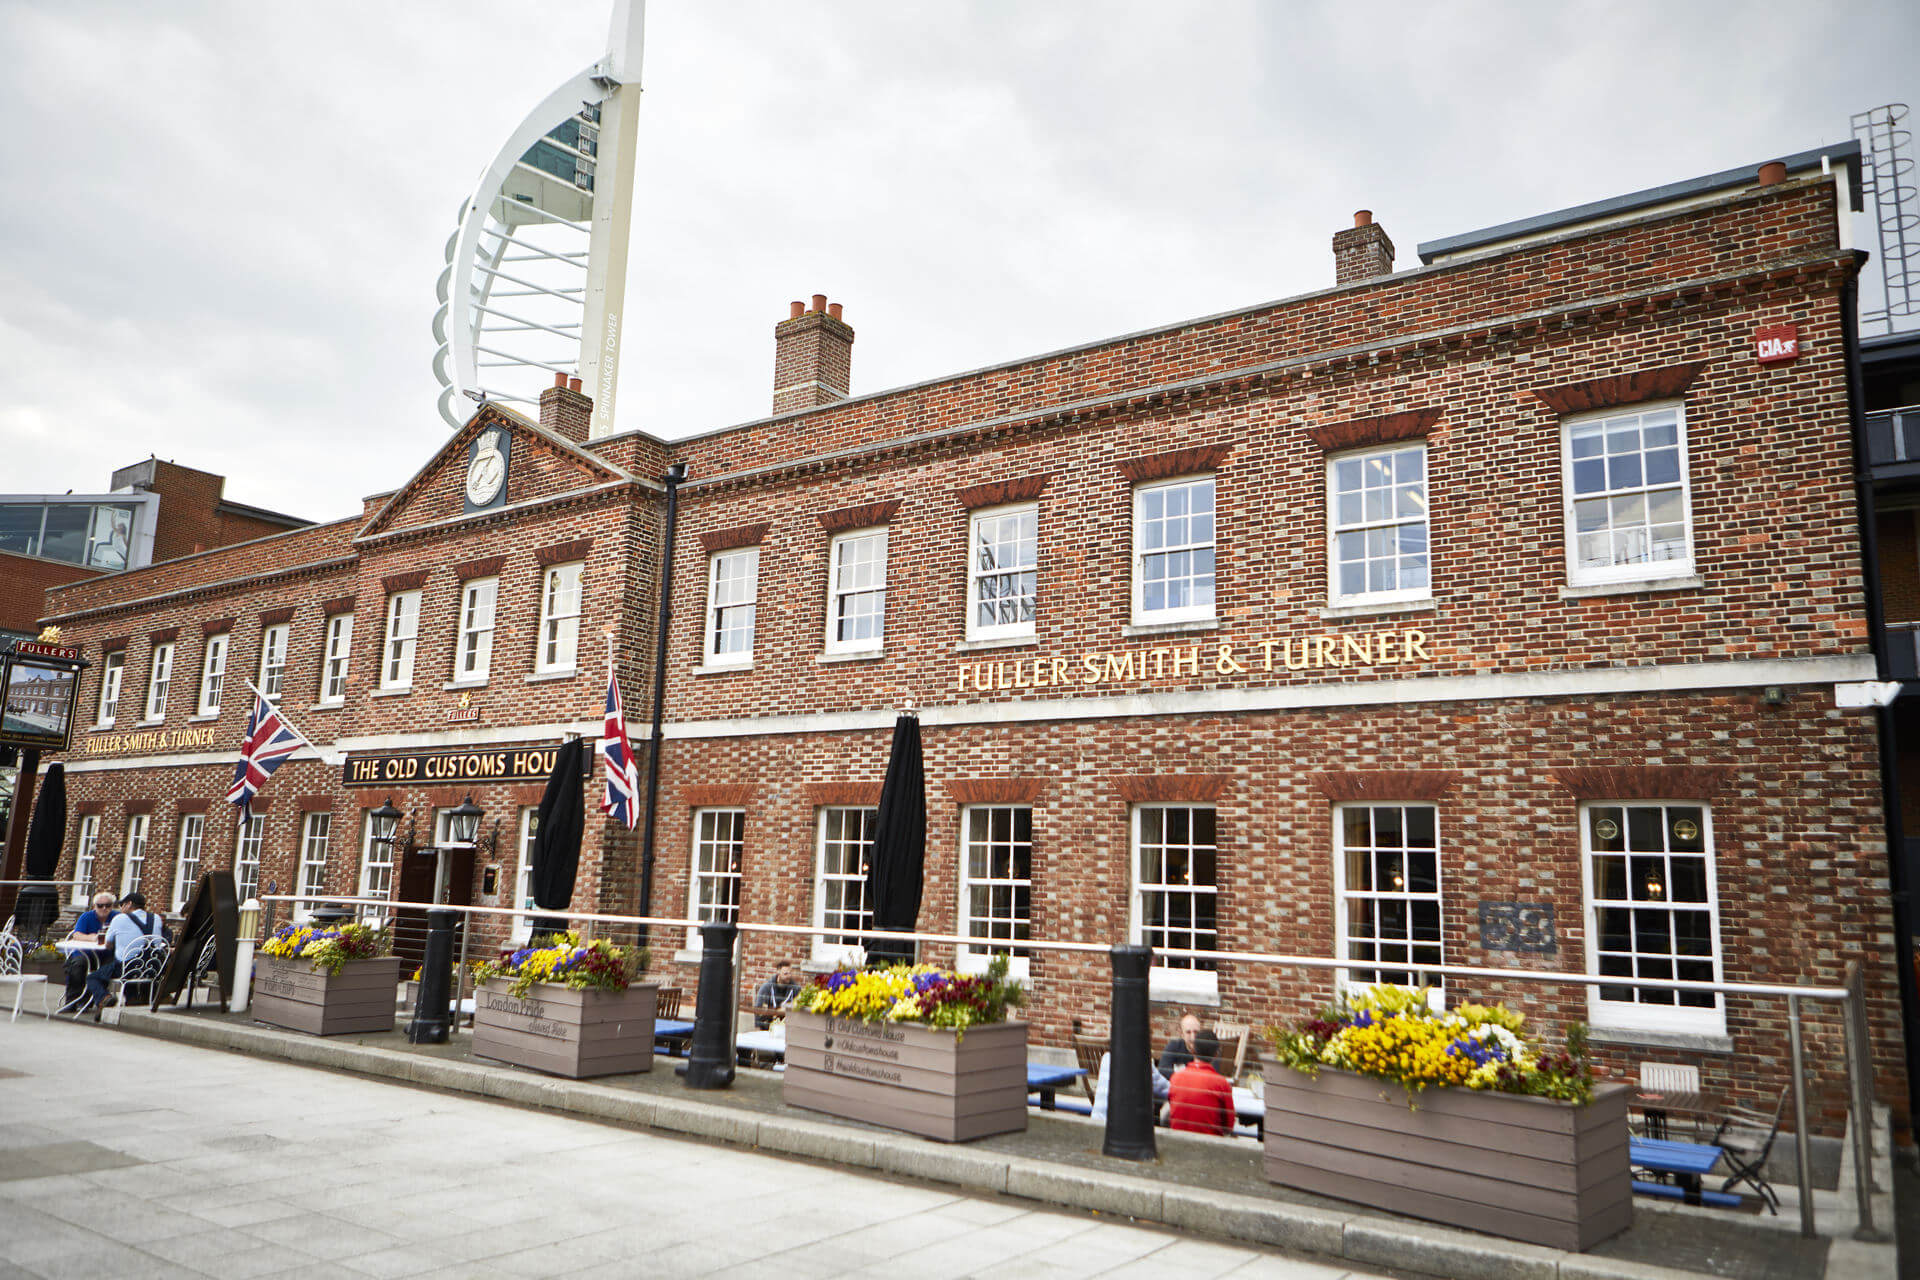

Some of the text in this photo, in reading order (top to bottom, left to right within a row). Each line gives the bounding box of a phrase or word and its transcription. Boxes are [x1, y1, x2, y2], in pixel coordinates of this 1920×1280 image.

[606, 313, 617, 353] TOWER
[600, 355, 615, 421] SPINNAKER
[957, 629, 1431, 692] FULLER SMITH & TURNER
[87, 728, 215, 753] FULLER SMITH & TURNER
[352, 750, 558, 780] THE OLD CUSTOMS HOU
[487, 992, 545, 1018] London Pride
